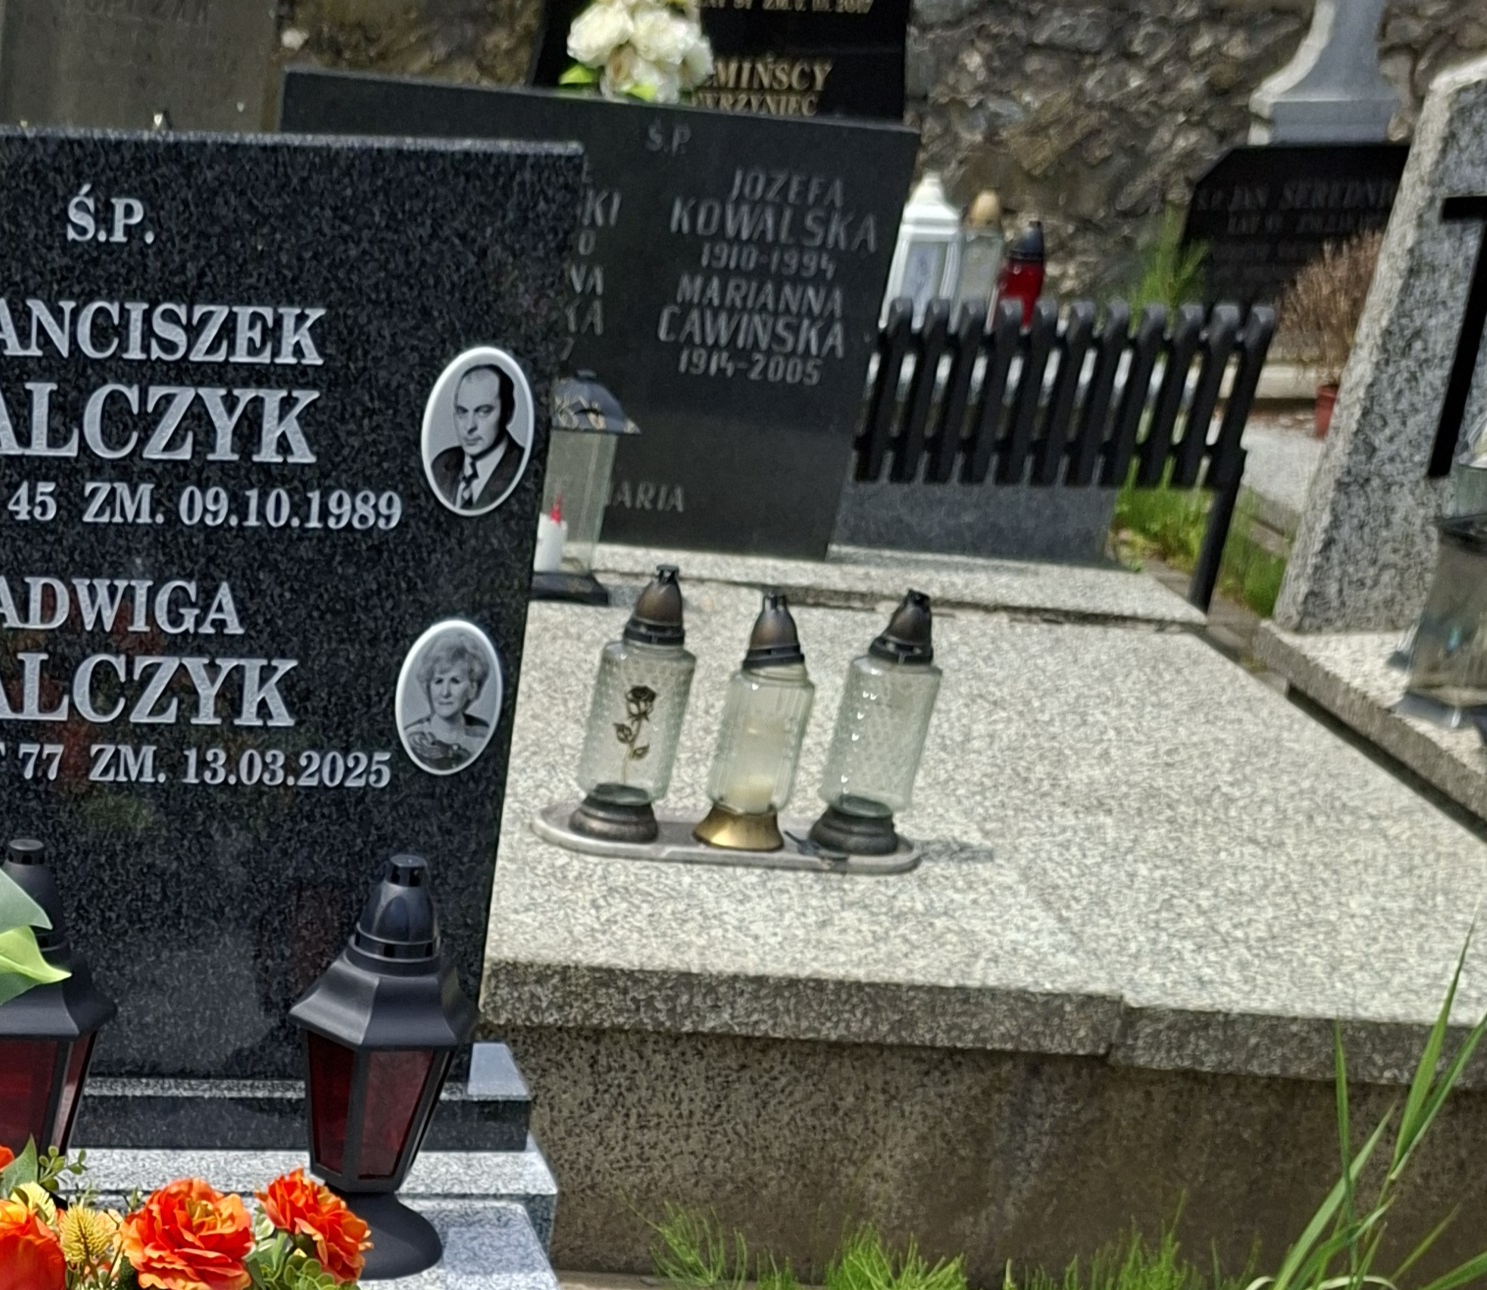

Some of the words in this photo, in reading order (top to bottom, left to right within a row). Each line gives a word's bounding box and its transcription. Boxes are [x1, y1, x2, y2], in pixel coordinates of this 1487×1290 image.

[66, 184, 156, 243] Ś.P.
[670, 195, 877, 253] KOWALSKA
[677, 271, 842, 318] MARIANNA
[7, 480, 58, 521] 45
[82, 481, 165, 524] ZM.
[177, 484, 403, 532] 09.10.1989
[612, 480, 684, 513] ARIA
[18, 743, 65, 781] 77
[89, 743, 167, 784] ZM.
[183, 747, 393, 788] 13.03.2025
